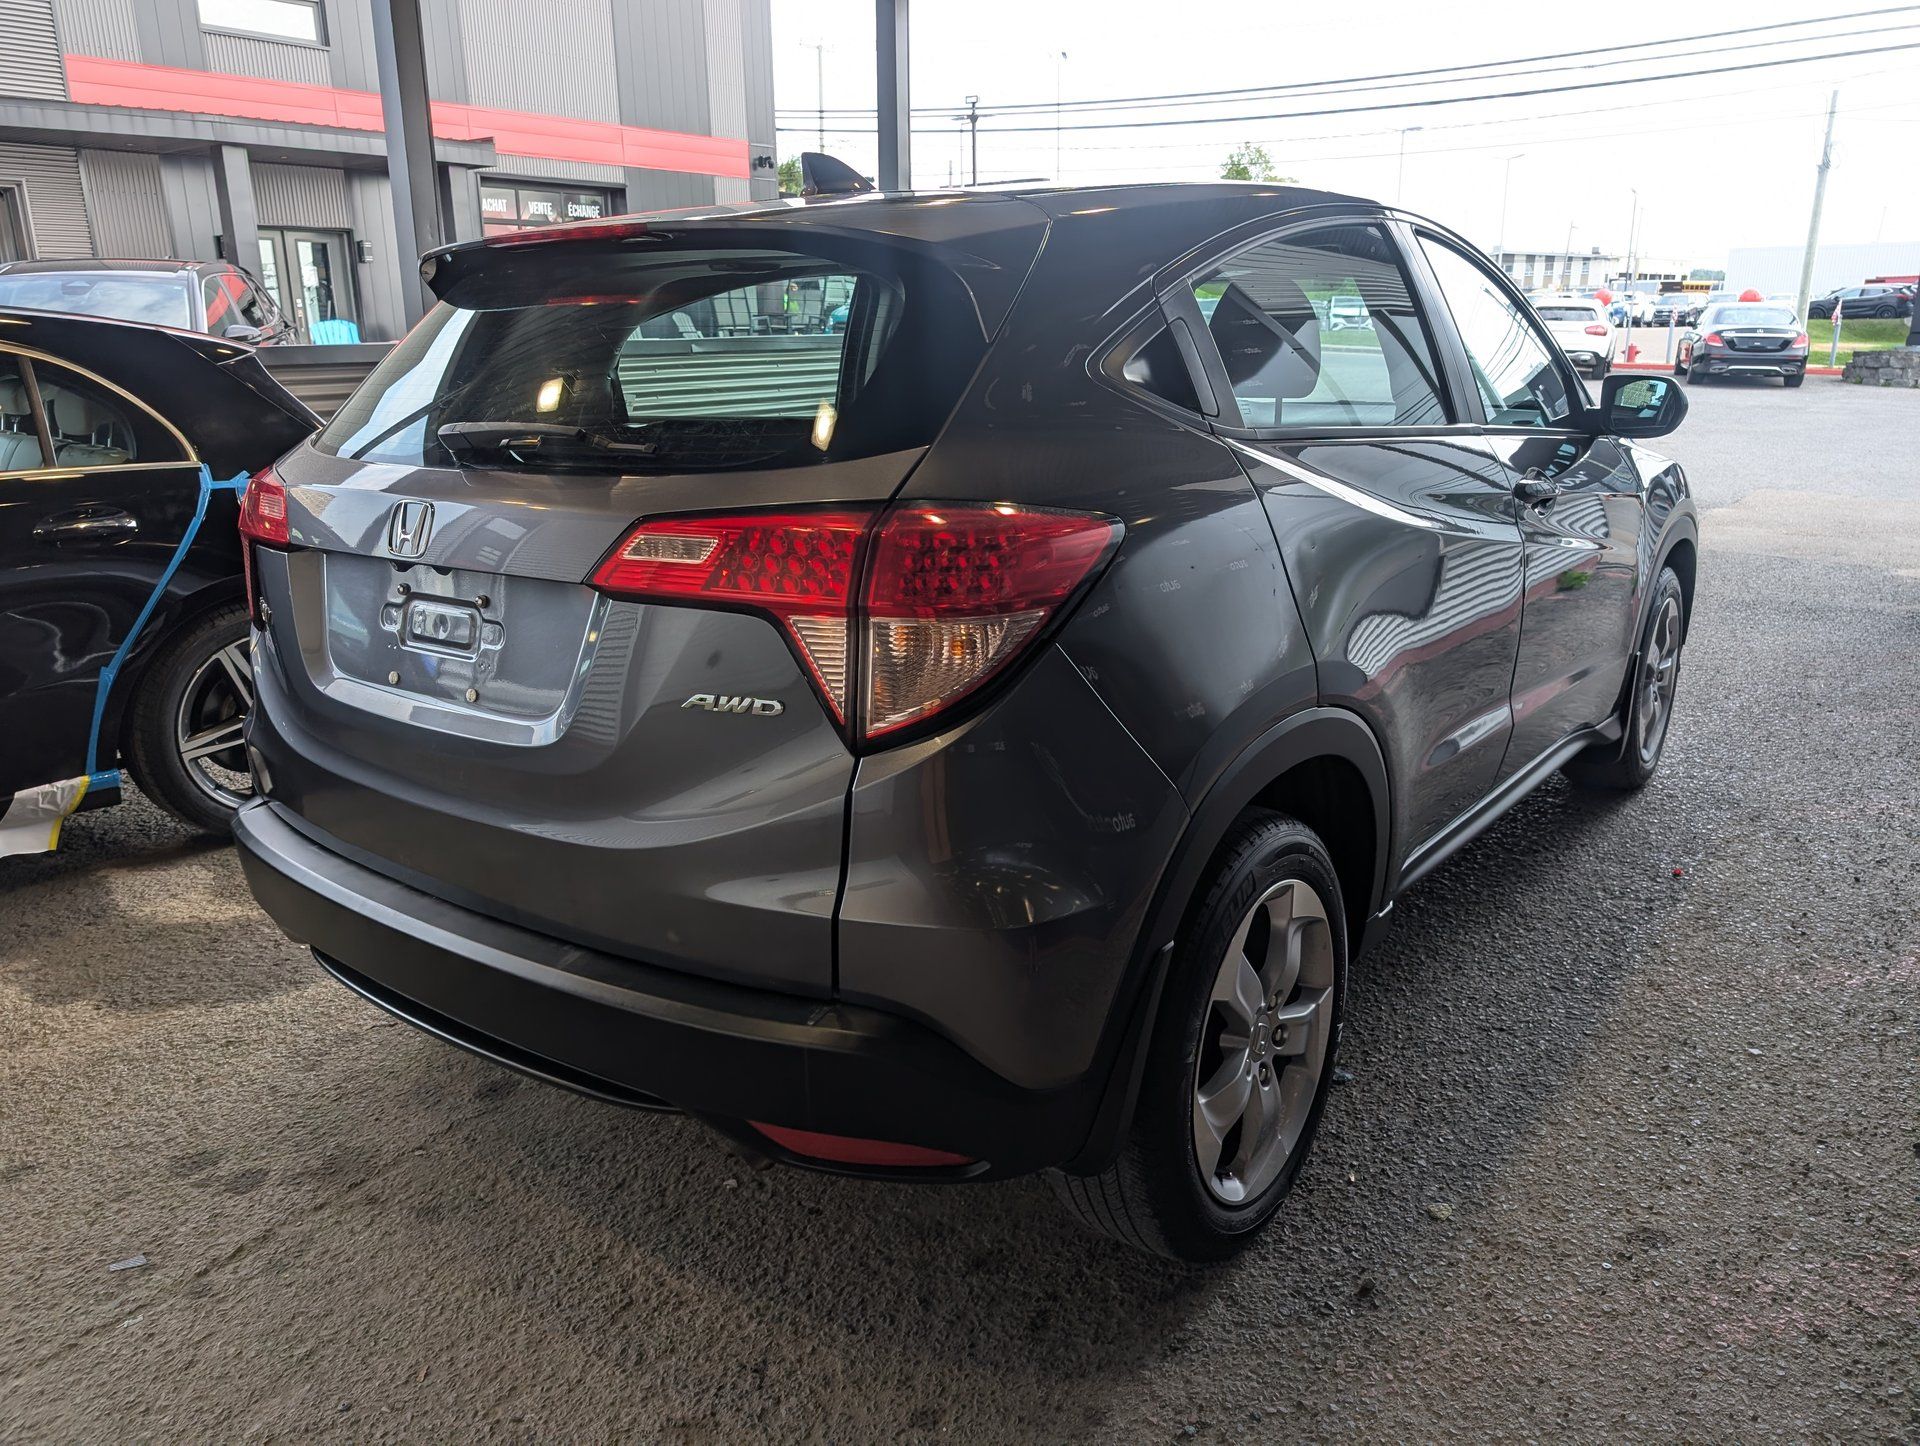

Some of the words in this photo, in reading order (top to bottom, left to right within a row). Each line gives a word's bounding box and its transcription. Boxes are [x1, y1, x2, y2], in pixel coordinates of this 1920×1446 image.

[482, 198, 507, 212] ACHAT
[528, 201, 553, 215] VENTE
[568, 202, 600, 218] ÉCHANGE
[680, 693, 785, 717] AWD
